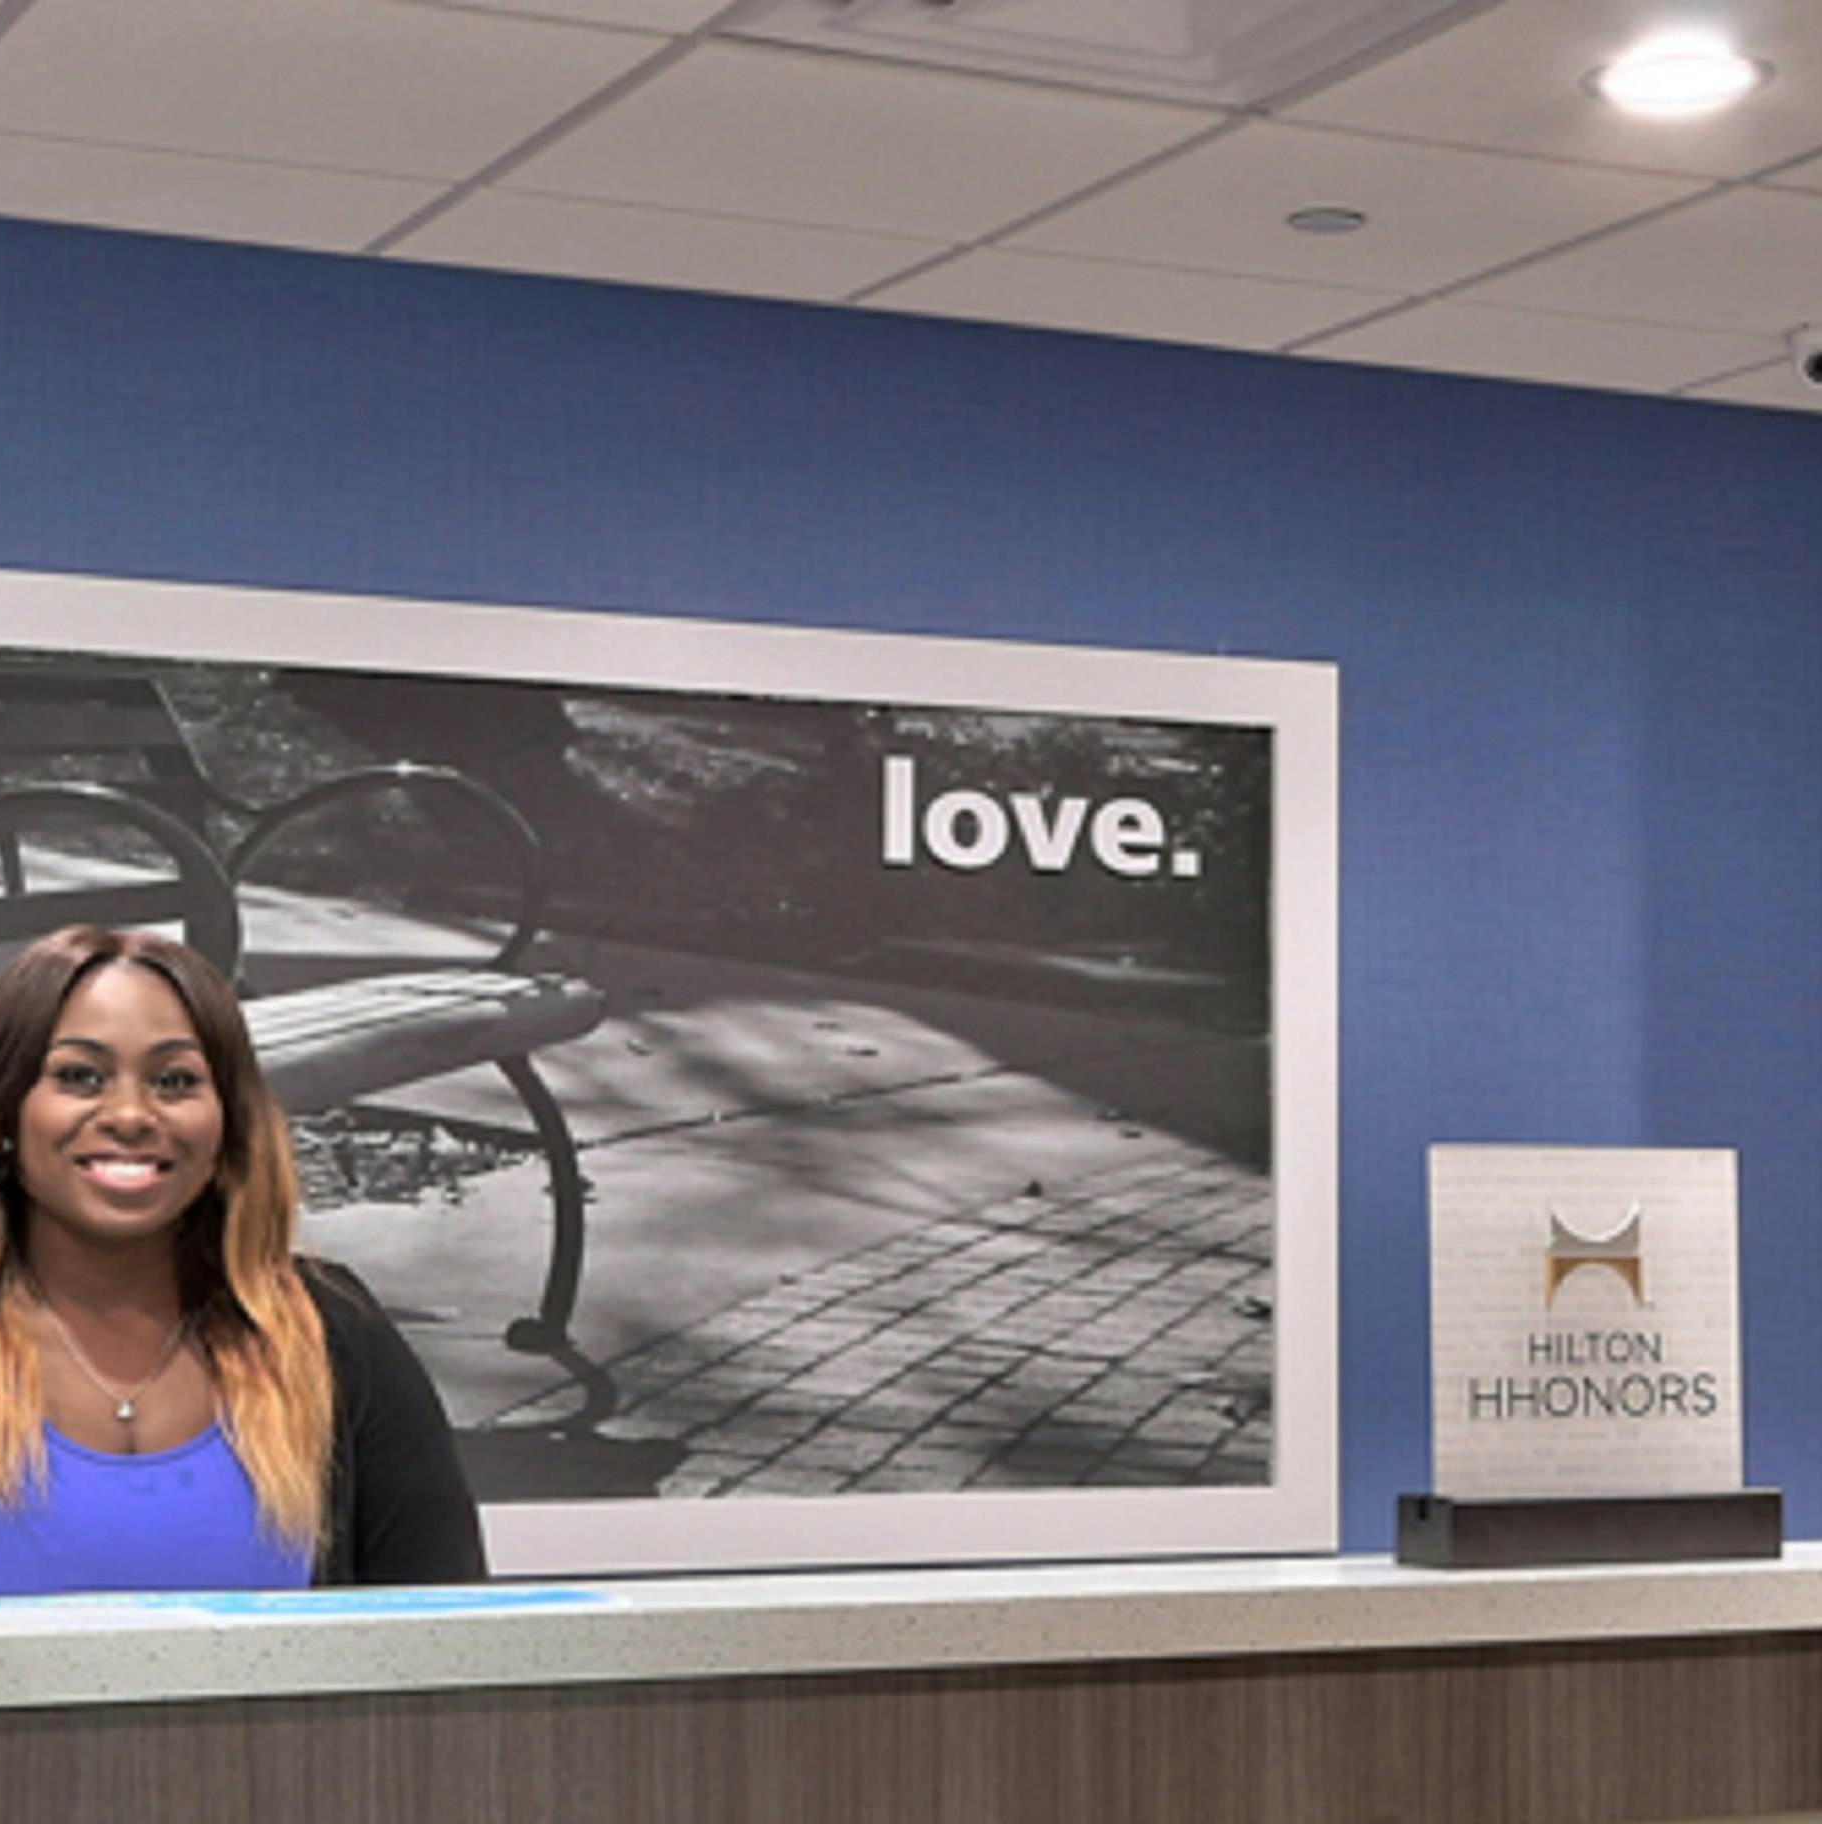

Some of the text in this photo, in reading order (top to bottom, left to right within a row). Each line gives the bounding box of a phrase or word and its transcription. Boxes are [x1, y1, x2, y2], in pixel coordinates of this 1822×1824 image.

[883, 756, 1201, 877] love.
[1528, 1331, 1662, 1365] HILTON
[1468, 1373, 1718, 1422] HHONORS
